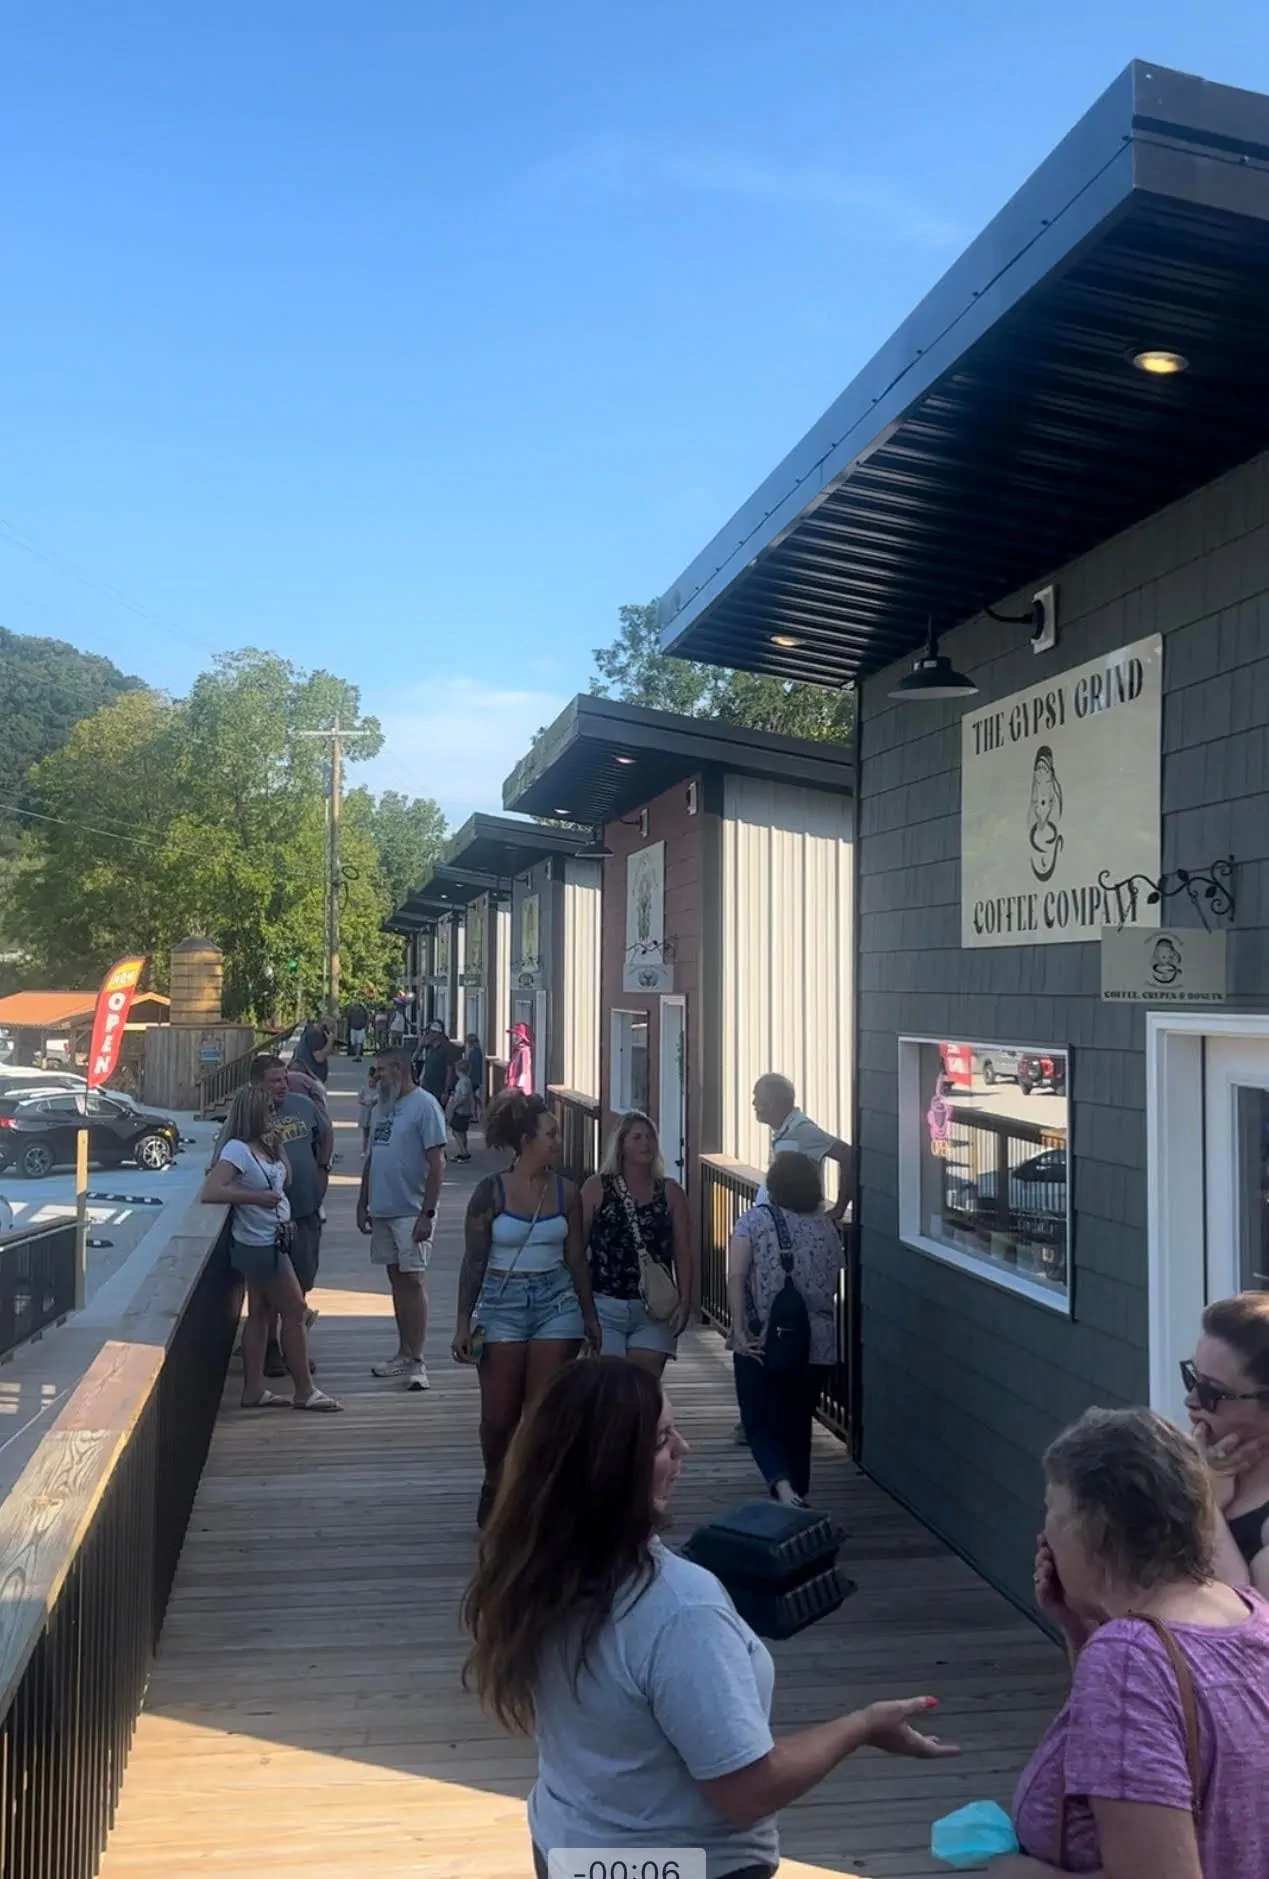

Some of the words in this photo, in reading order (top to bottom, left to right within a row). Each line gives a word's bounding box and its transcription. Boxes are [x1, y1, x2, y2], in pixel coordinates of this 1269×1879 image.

[972, 711, 1005, 755] THE
[1009, 687, 1068, 742] GYPSY
[1073, 657, 1144, 719] GRIND
[973, 893, 1038, 935] COFFEE
[1043, 880, 1138, 929] COMPANY
[94, 992, 127, 1074] OPEN
